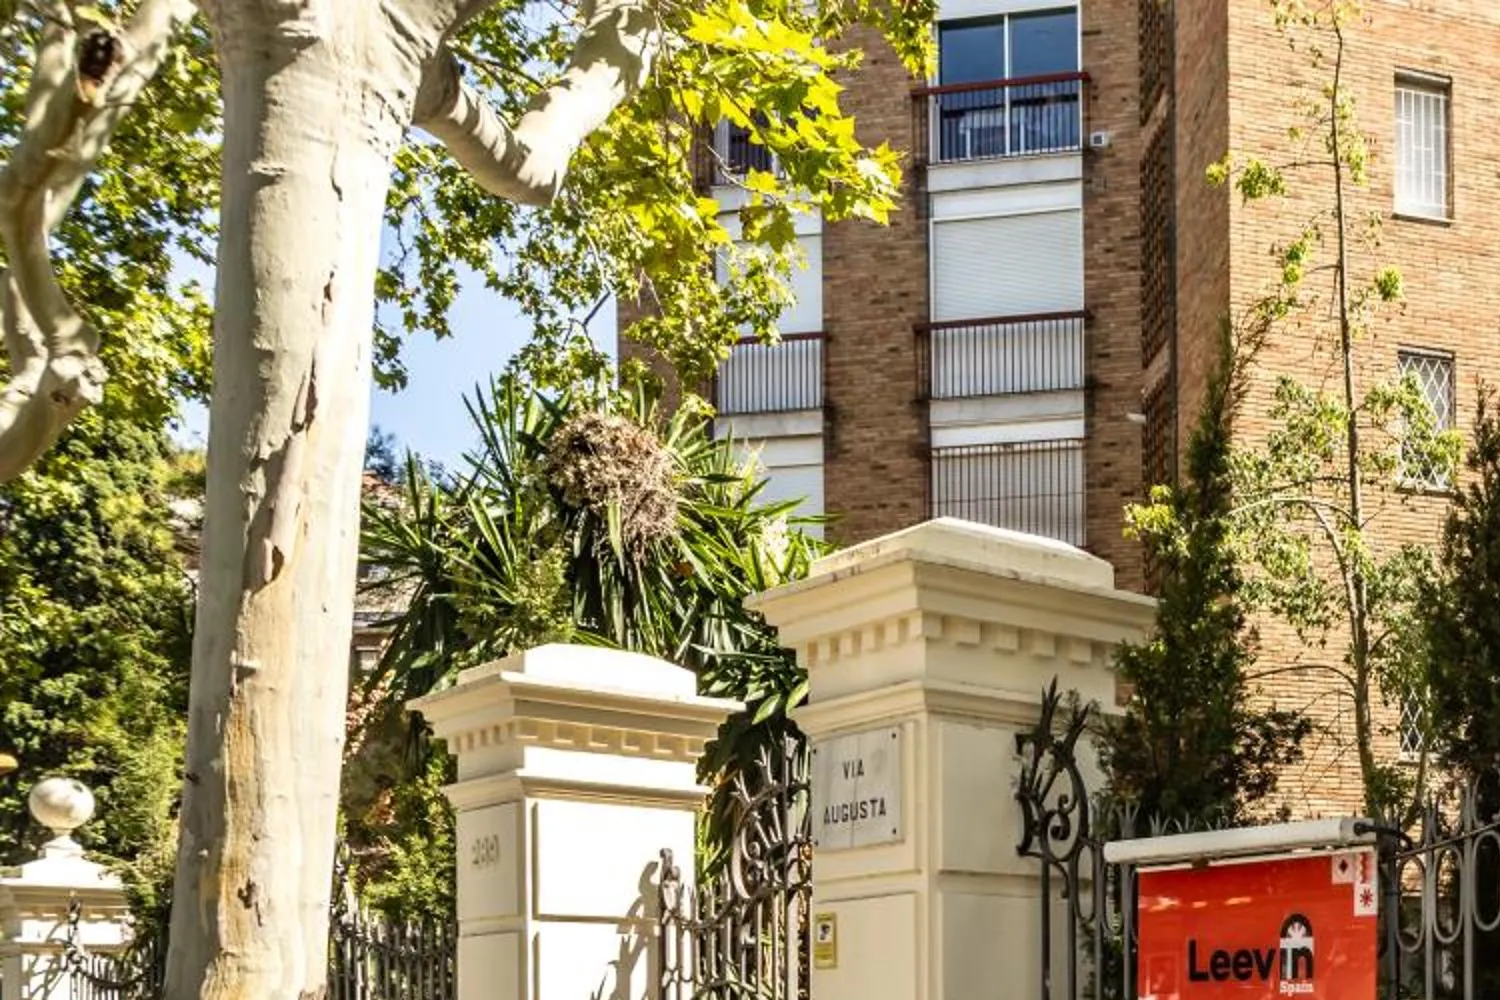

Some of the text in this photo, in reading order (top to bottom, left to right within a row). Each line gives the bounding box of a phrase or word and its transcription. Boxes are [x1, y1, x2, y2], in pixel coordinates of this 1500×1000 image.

[843, 759, 864, 779] VIA
[824, 798, 886, 824] AUGUSTA
[1188, 939, 1314, 982] Leevin
[1280, 980, 1314, 996] Spain
